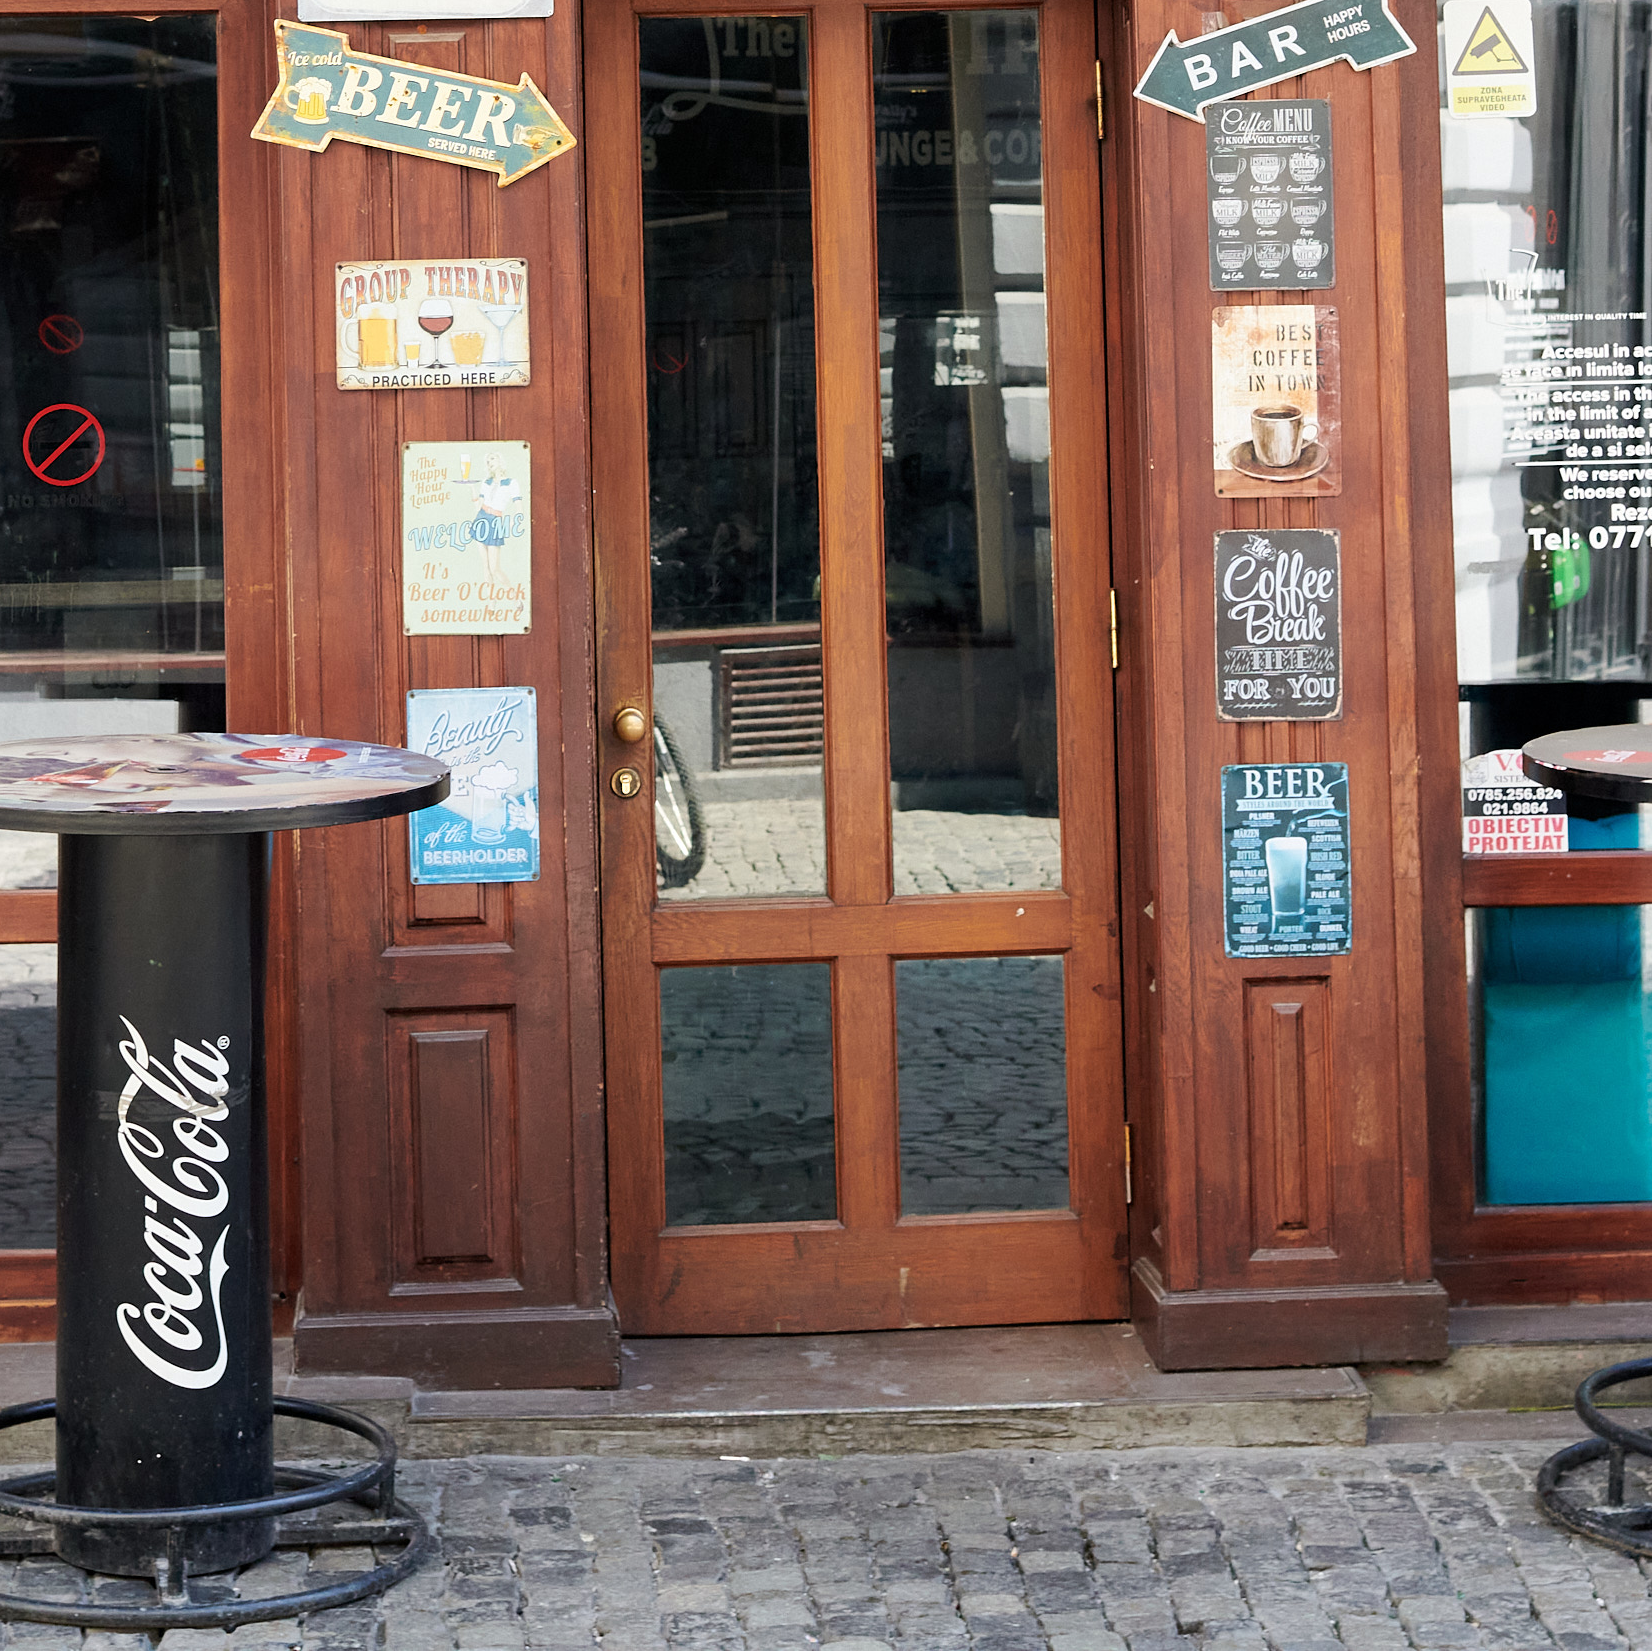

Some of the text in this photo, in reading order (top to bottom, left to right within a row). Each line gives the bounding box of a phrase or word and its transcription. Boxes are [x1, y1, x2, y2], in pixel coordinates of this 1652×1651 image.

[1323, 4, 1364, 28] HAPPY
[1327, 19, 1371, 44] HOURS
[287, 50, 343, 67] Ice cold
[1183, 24, 1307, 91] BAR
[1456, 94, 1527, 104] SUPRAVEGHEATA
[1480, 87, 1503, 95] ZONA
[330, 62, 517, 148] BEER
[1480, 102, 1505, 112] VIDEO
[1220, 108, 1313, 141] Coffee MENU
[427, 136, 497, 161] SERVED HERE
[1225, 135, 1309, 145] KNOW YOUR COFFEE
[339, 266, 525, 319] GROUP THERAPY
[1496, 279, 1524, 301] The
[1547, 312, 1648, 321] INTEREST IN QUALITY TIME
[1276, 324, 1325, 342] BEST
[1252, 348, 1326, 367] COFFEE
[1541, 343, 1610, 361] Accesul
[1613, 343, 1629, 359] in
[1585, 361, 1635, 377] limita
[372, 372, 496, 388] PRACTICED HERE
[1248, 374, 1327, 393] IN TOWN
[1551, 389, 1610, 403] access
[1613, 386, 1630, 402] in
[1547, 406, 1576, 421] the
[1579, 404, 1619, 420] limit
[1621, 403, 1641, 420] of
[1510, 425, 1580, 441] Aceasta
[1583, 424, 1646, 440] unitate
[1565, 443, 1588, 458] de
[1592, 447, 1603, 458] a
[1607, 442, 1622, 457] si
[418, 456, 437, 470] The
[409, 467, 448, 484] Happy
[1560, 467, 1588, 483] We
[415, 480, 445, 495] Hour
[1563, 484, 1627, 500] choose
[409, 491, 452, 510] Lounge
[407, 512, 526, 553] WELCOME
[1528, 526, 1581, 551] Tel:
[422, 562, 449, 580] It's
[407, 581, 526, 602] Beer O'Clock
[1223, 550, 1335, 619] Coffee
[420, 604, 522, 624] somewhere
[1230, 599, 1327, 645] Break
[1249, 650, 1311, 670] TIME
[1224, 678, 1272, 701] FOR
[1287, 673, 1336, 700] YOU
[424, 696, 525, 757] Beauty
[463, 745, 481, 764] the
[1243, 768, 1332, 799] BEER
[1467, 787, 1564, 801] 0785.256.824
[1482, 802, 1549, 815] 021.9864
[423, 821, 468, 848] of the
[1467, 817, 1565, 834] OBIECTIV
[1468, 835, 1565, 852] PROTEJAT
[423, 847, 529, 866] BEERHOLDER
[116, 1015, 232, 1390] Coca-Cola
